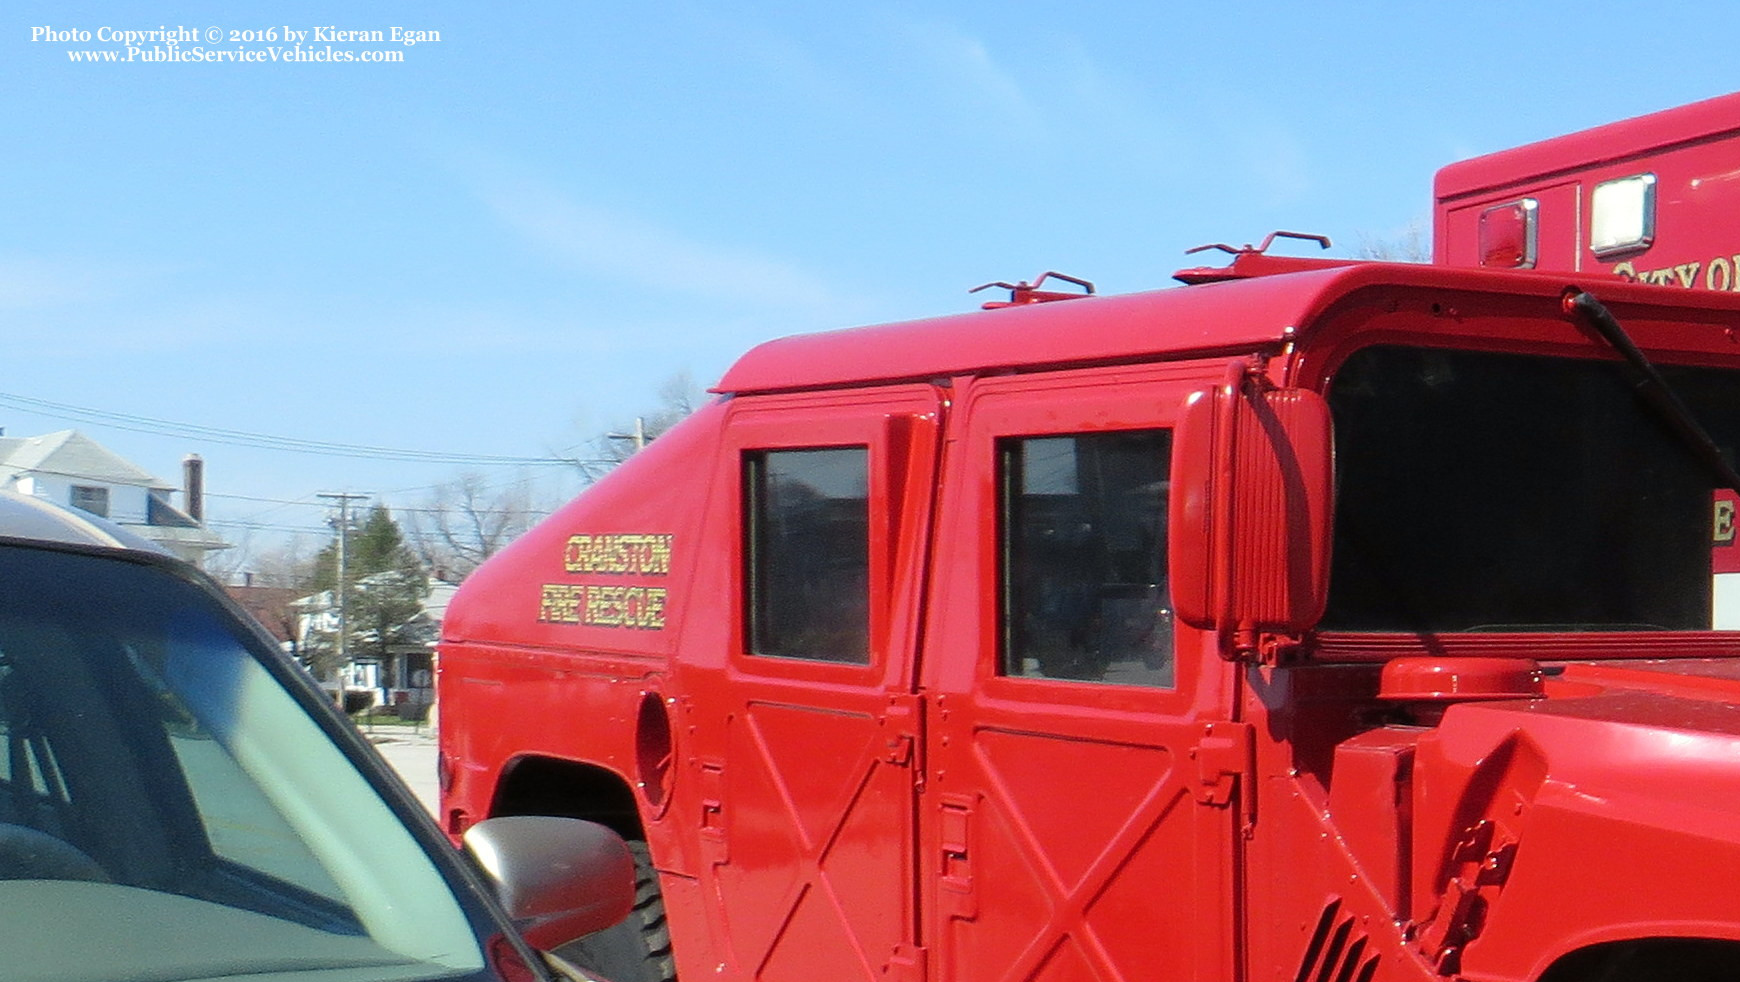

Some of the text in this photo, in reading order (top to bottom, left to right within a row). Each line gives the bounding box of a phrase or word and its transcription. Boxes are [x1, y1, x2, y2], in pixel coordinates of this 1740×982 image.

[564, 533, 674, 576] CRANSTON
[537, 583, 667, 630] FIRE RESCUE
